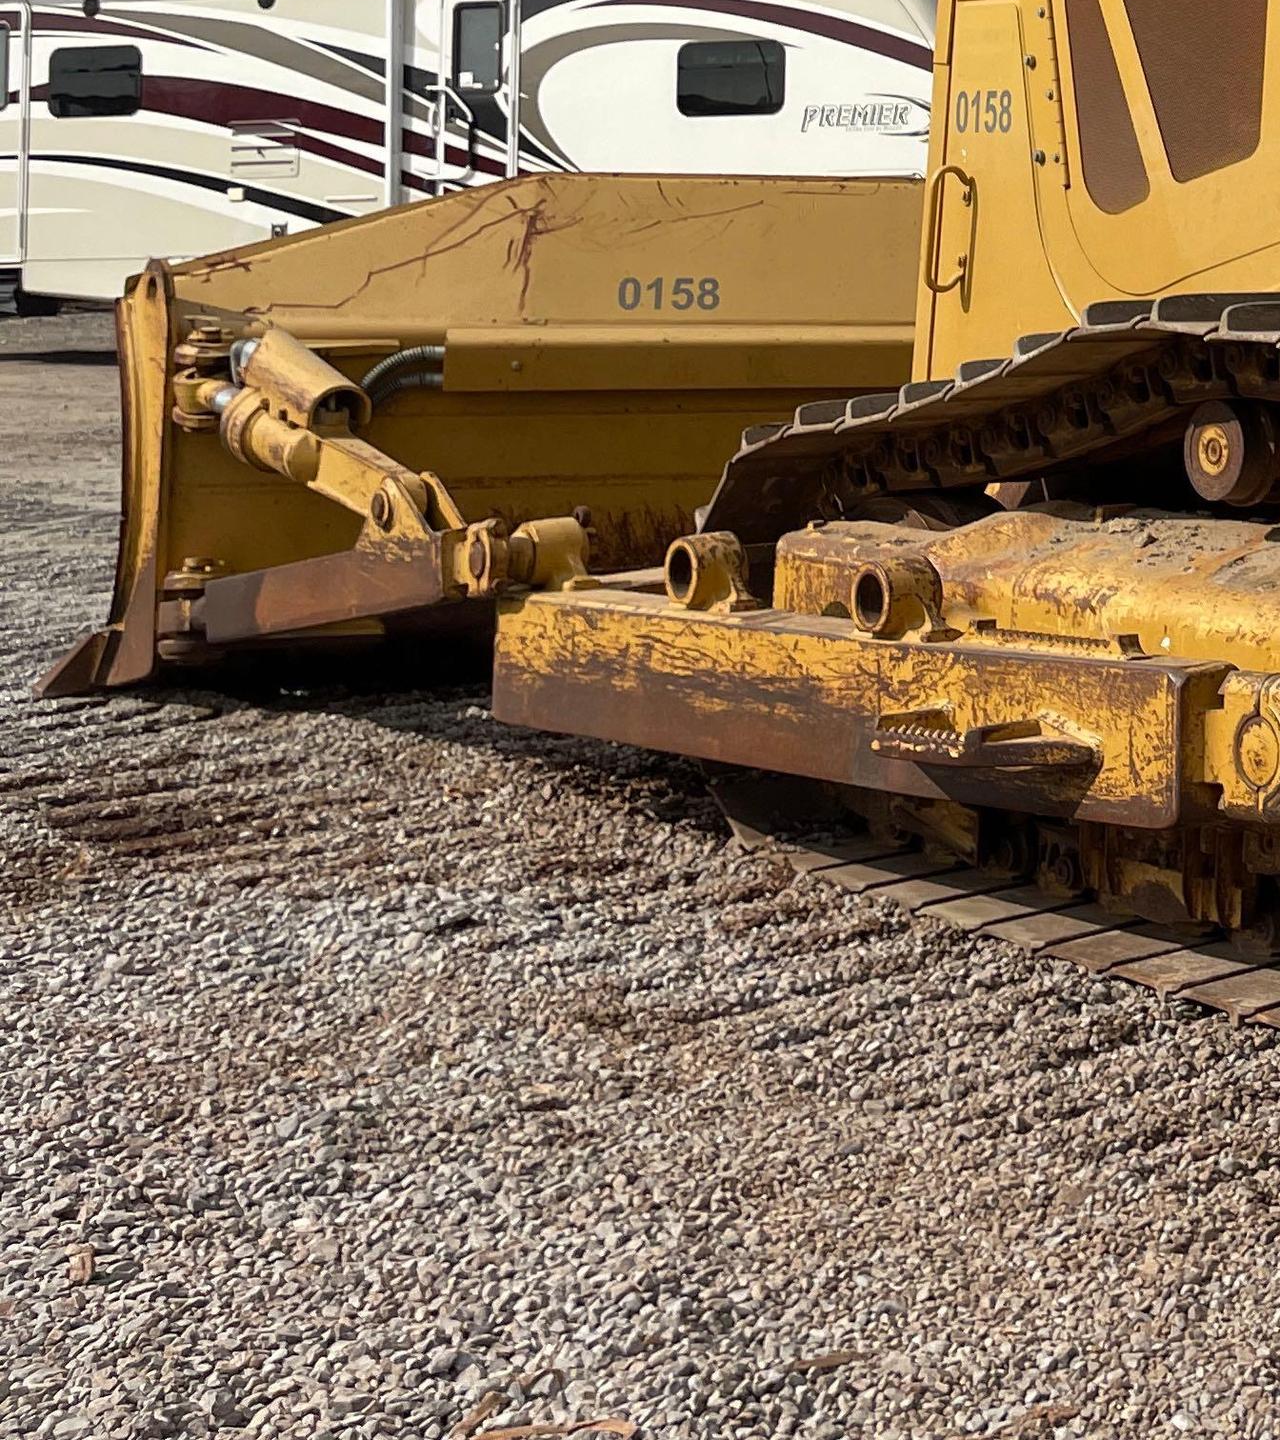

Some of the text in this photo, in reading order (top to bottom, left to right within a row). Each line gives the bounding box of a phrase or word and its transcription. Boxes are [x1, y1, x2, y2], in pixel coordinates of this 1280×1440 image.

[800, 102, 912, 133] PREMIER
[956, 89, 1012, 133] 0158
[618, 276, 720, 311] 0158
